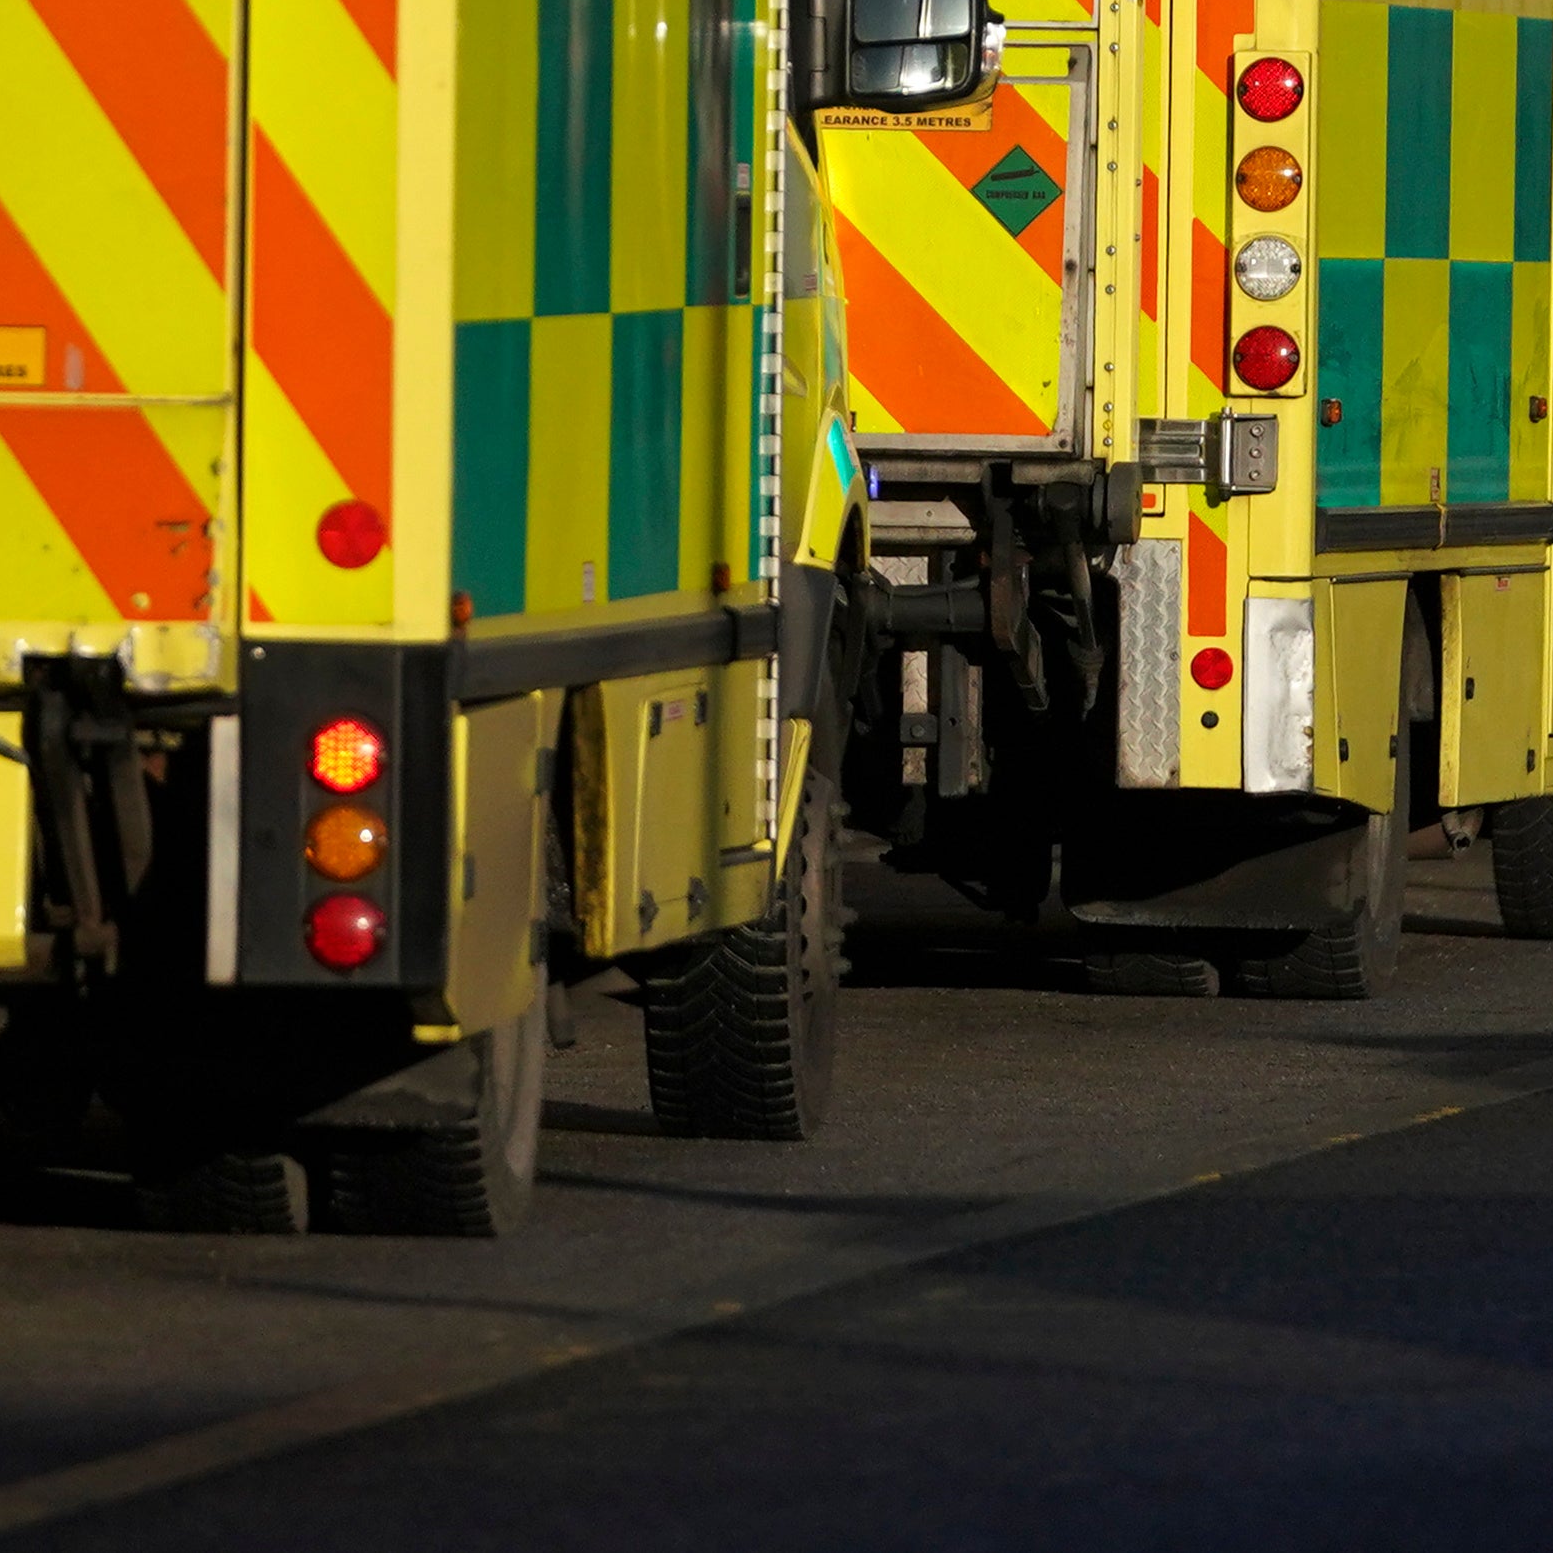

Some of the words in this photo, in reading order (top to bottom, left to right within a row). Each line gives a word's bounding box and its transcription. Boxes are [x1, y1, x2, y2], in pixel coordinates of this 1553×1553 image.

[821, 115, 888, 127] EARANCE
[893, 116, 913, 127] 3.5
[916, 117, 972, 128] METRES
